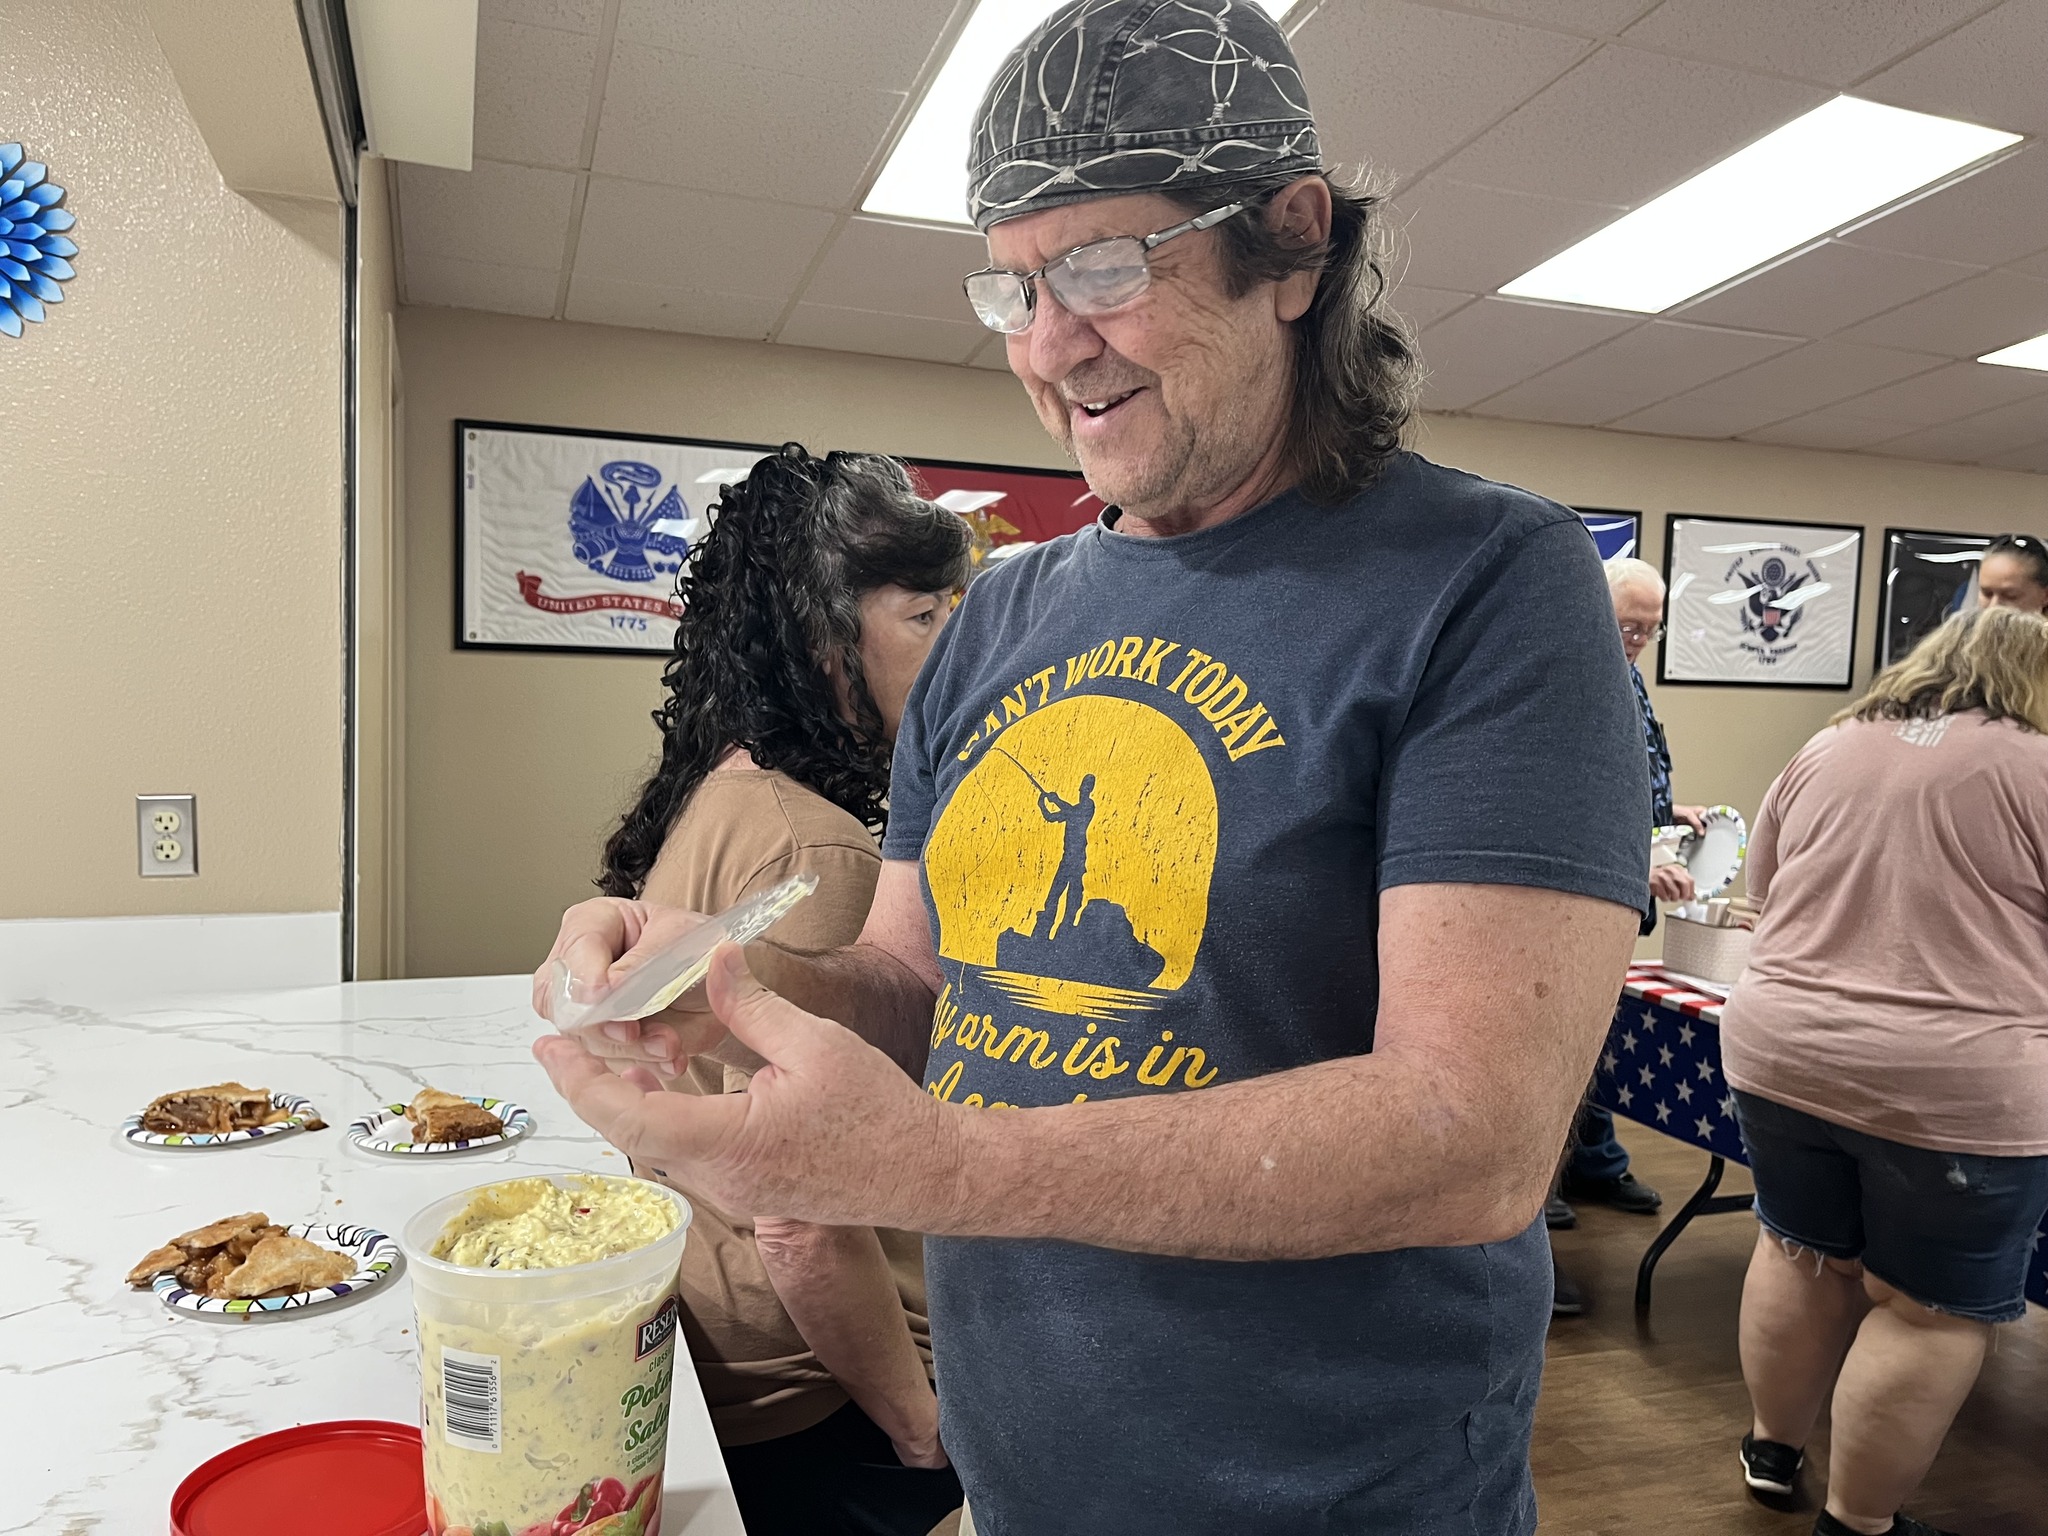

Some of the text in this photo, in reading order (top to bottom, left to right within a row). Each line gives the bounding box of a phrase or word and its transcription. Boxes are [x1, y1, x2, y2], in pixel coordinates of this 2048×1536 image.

[537, 597, 596, 612] UNITED
[602, 596, 662, 613] STATES
[610, 616, 647, 631] 1775
[957, 636, 1286, 762] CAN'T WORK TODAY
[956, 1013, 1058, 1069] arm
[1062, 1022, 1129, 1080] is
[1136, 1030, 1219, 1088] in
[648, 1344, 673, 1373] class
[489, 1375, 497, 1403] 61556
[621, 1368, 673, 1418] Pota
[489, 1407, 498, 1433] 71117
[624, 1402, 670, 1452] Sala
